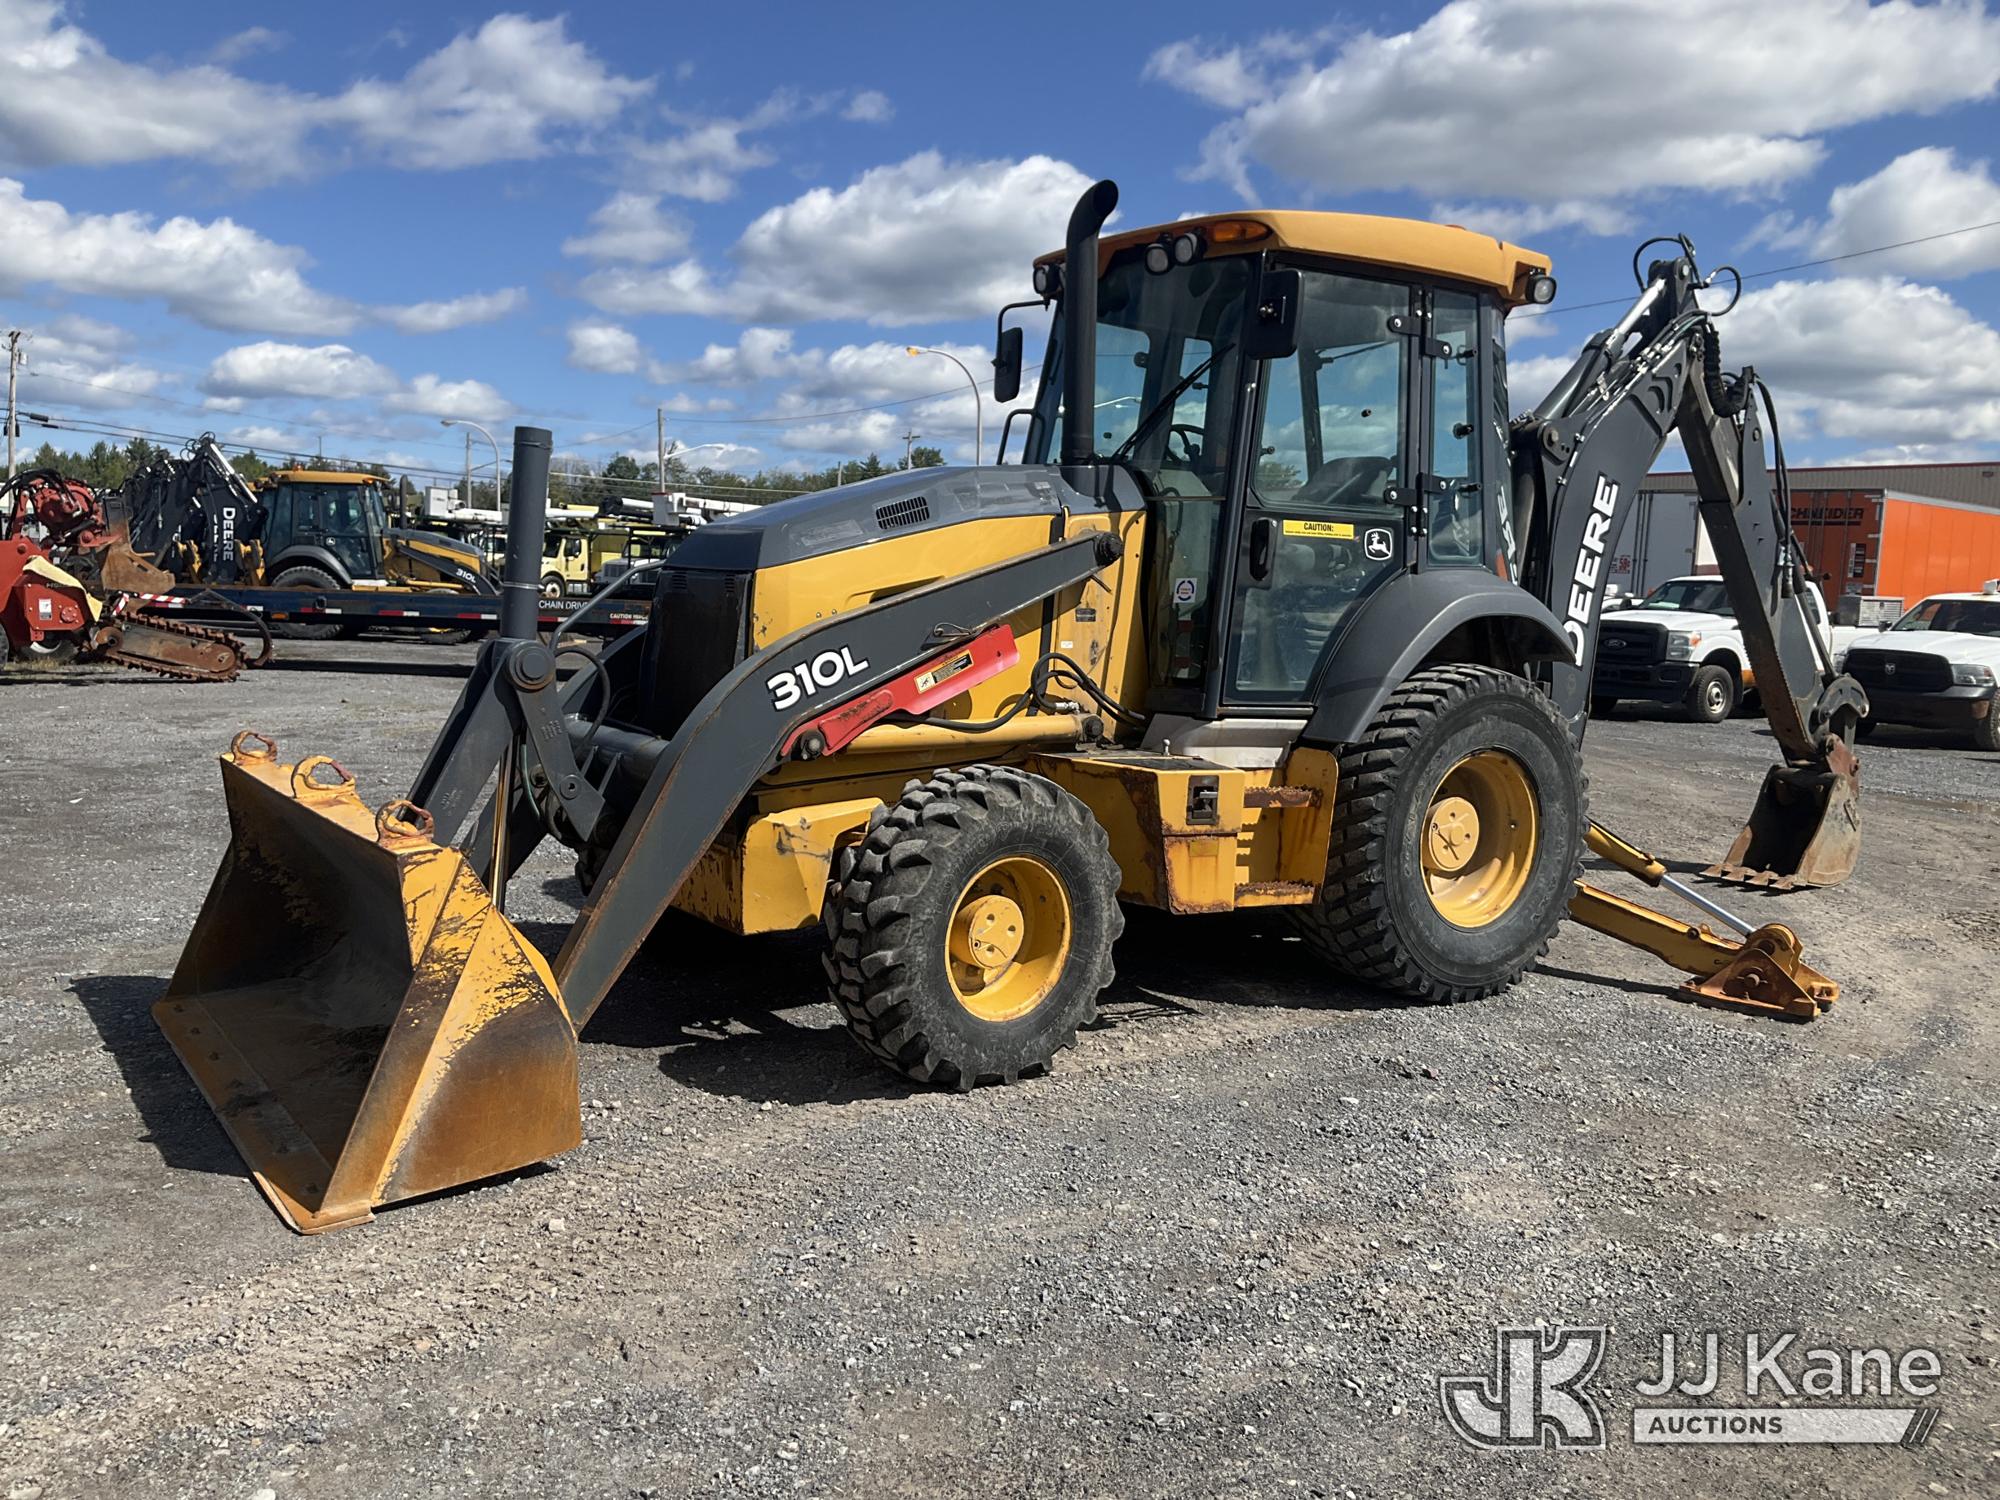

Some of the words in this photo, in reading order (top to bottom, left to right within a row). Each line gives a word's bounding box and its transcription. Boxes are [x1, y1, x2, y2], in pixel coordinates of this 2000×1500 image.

[1303, 522, 1334, 532] CAUTION:
[1791, 507, 1864, 519] CHNEIDER
[222, 507, 236, 561] DEERE
[1563, 475, 1619, 667] DEERE
[538, 600, 564, 609] CHAIN
[767, 646, 870, 710] 310L
